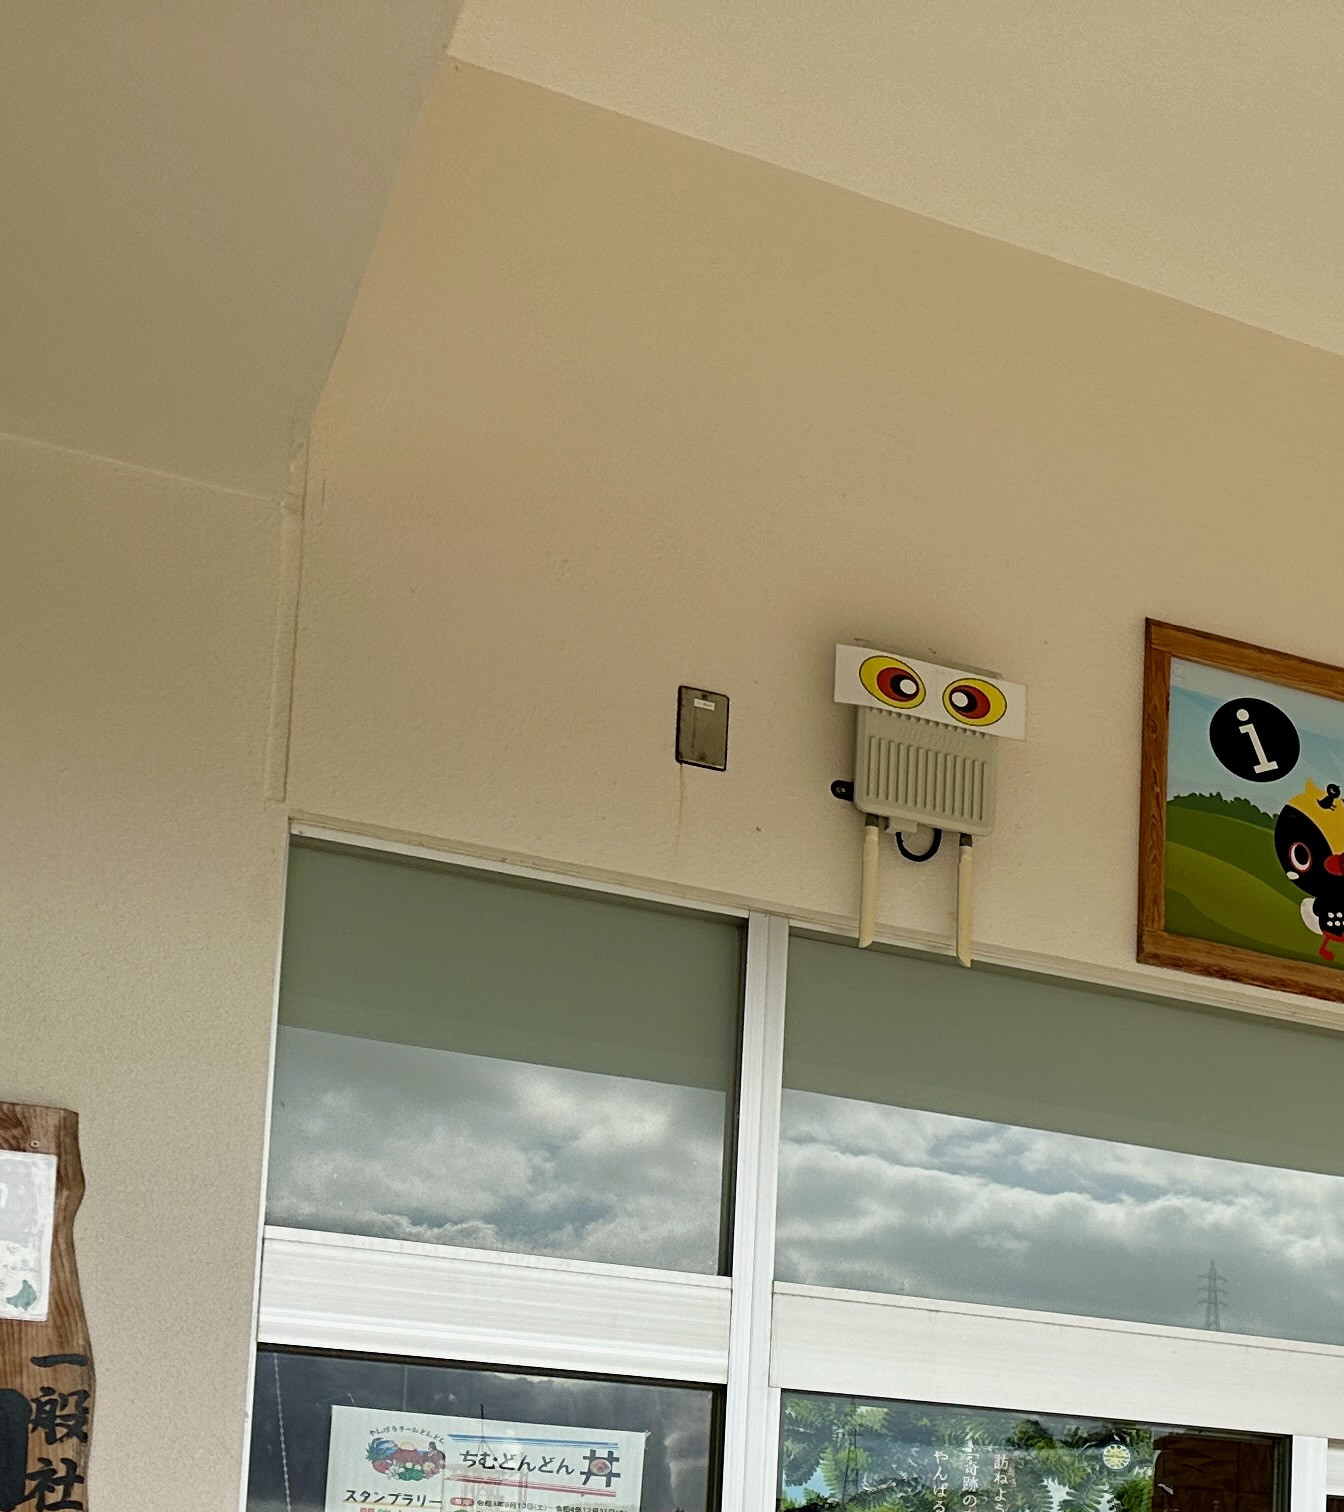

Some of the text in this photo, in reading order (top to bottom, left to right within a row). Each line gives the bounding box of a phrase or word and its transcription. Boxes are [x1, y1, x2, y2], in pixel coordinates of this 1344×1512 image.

[344, 1489, 442, 1507] スタンプラリー
